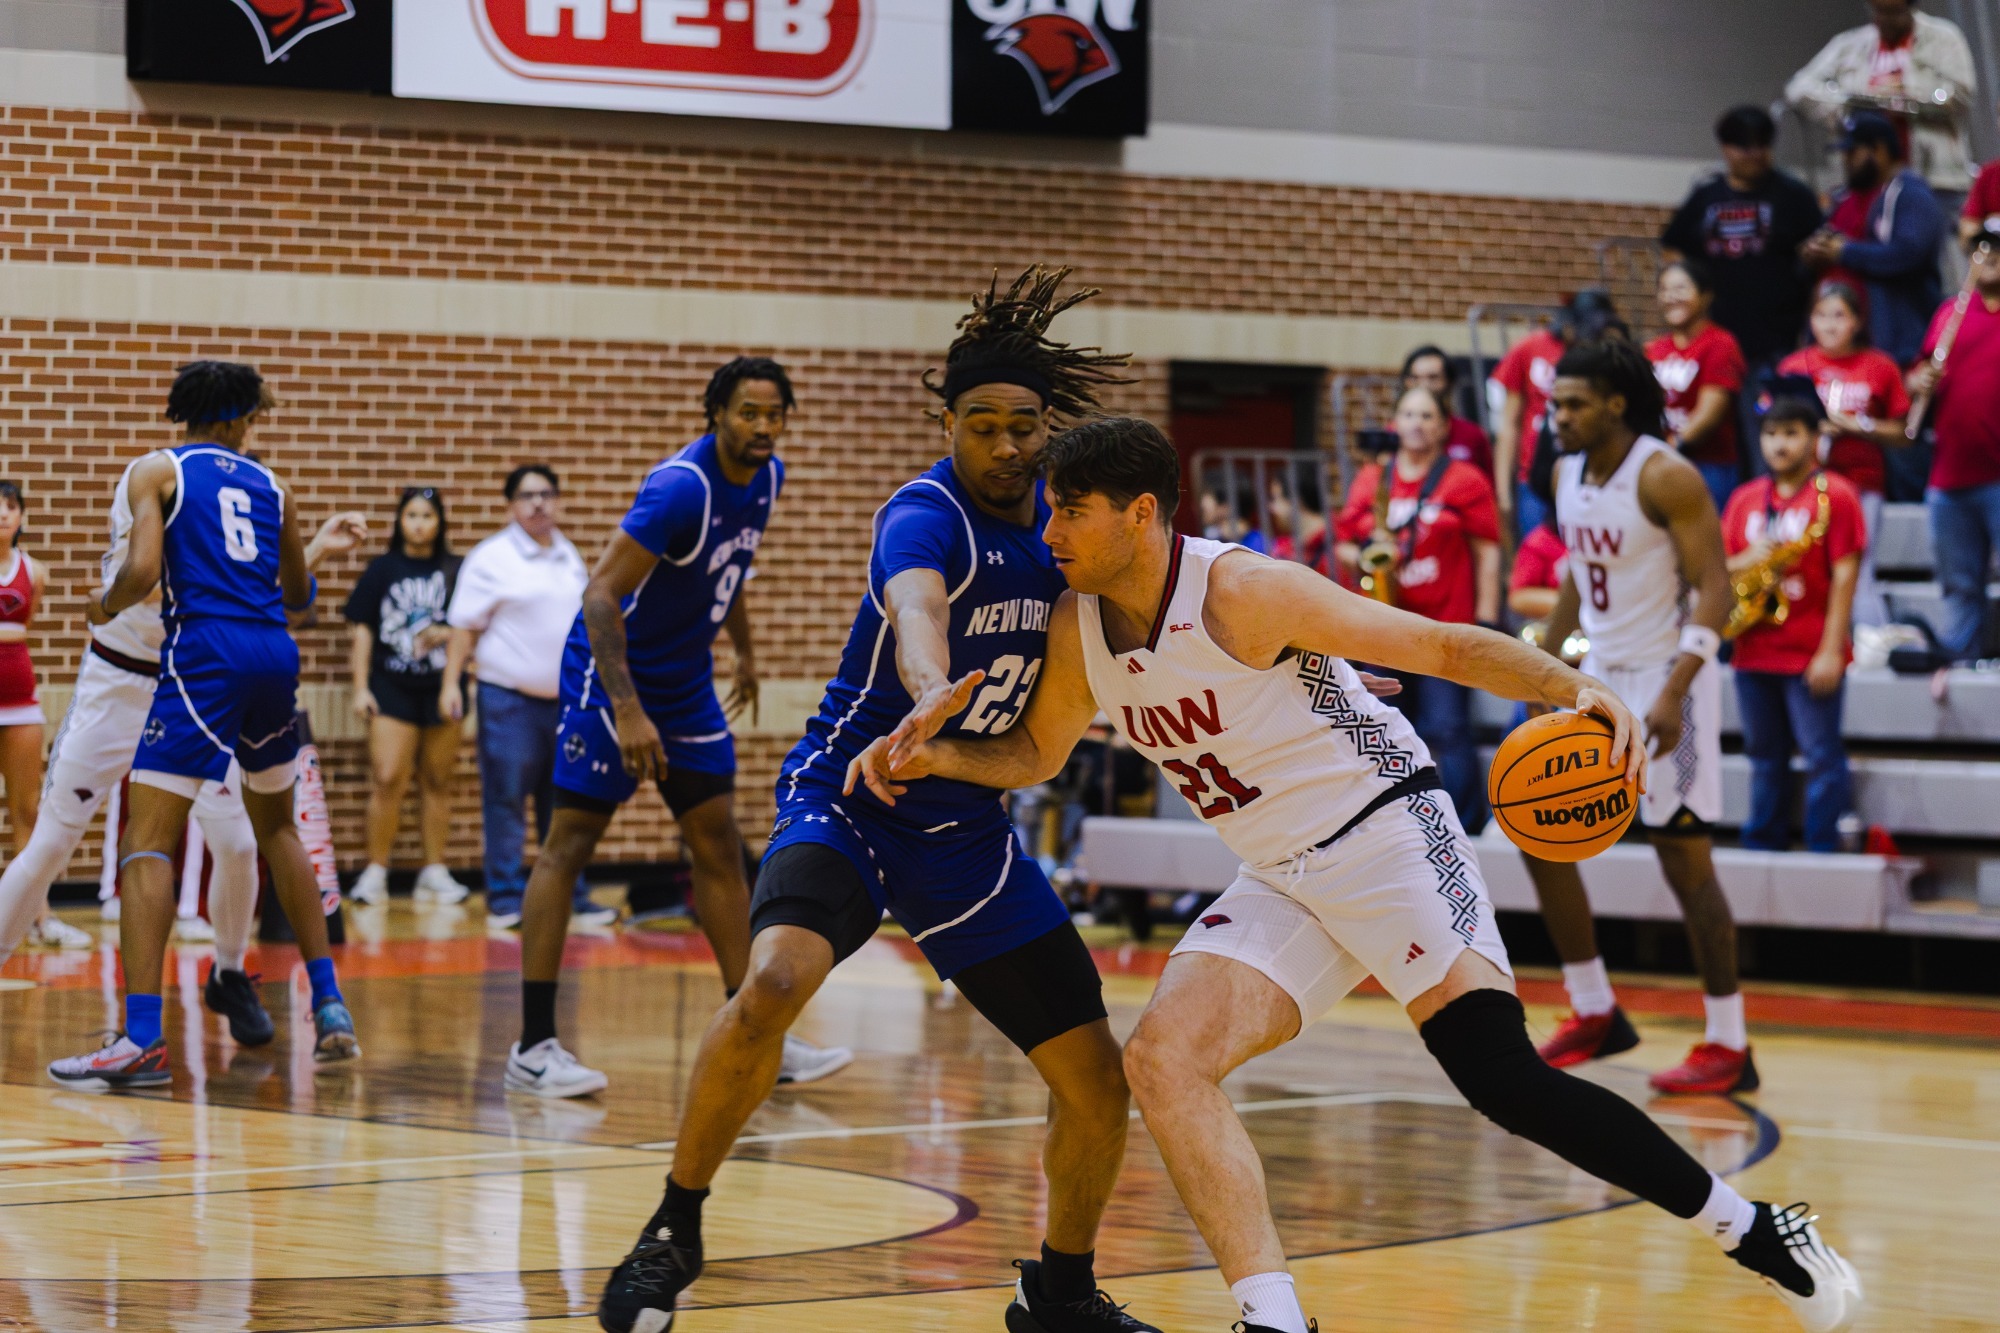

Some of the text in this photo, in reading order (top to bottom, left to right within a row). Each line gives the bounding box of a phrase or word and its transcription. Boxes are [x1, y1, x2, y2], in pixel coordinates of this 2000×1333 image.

[217, 487, 259, 562] 6
[710, 564, 741, 622] 9
[1587, 562, 1609, 612] 8
[964, 599, 1021, 637] NEW
[960, 654, 1043, 735] 23
[1120, 689, 1225, 748] UIW
[1162, 752, 1262, 819] 21
[1527, 773, 1544, 787] NXT
[1533, 788, 1631, 828] Wilson
